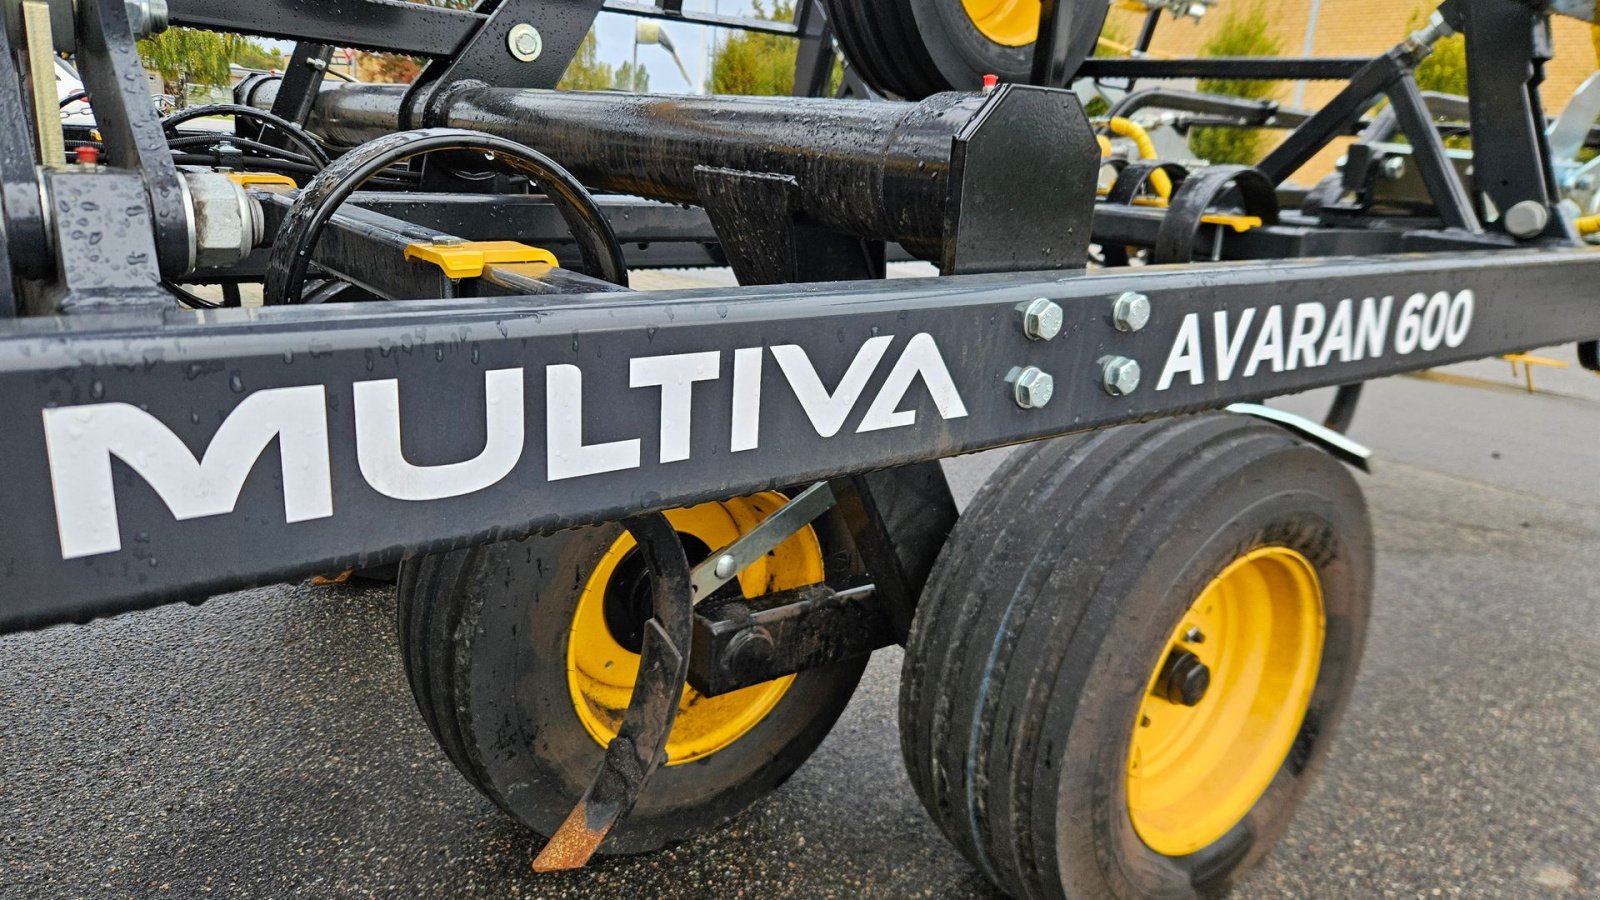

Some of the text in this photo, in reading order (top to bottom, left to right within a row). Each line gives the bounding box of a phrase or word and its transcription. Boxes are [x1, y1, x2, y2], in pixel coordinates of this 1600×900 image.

[1155, 295, 1394, 391] AVARAN
[1394, 288, 1475, 355] 600
[42, 332, 968, 560] MULTIVA
